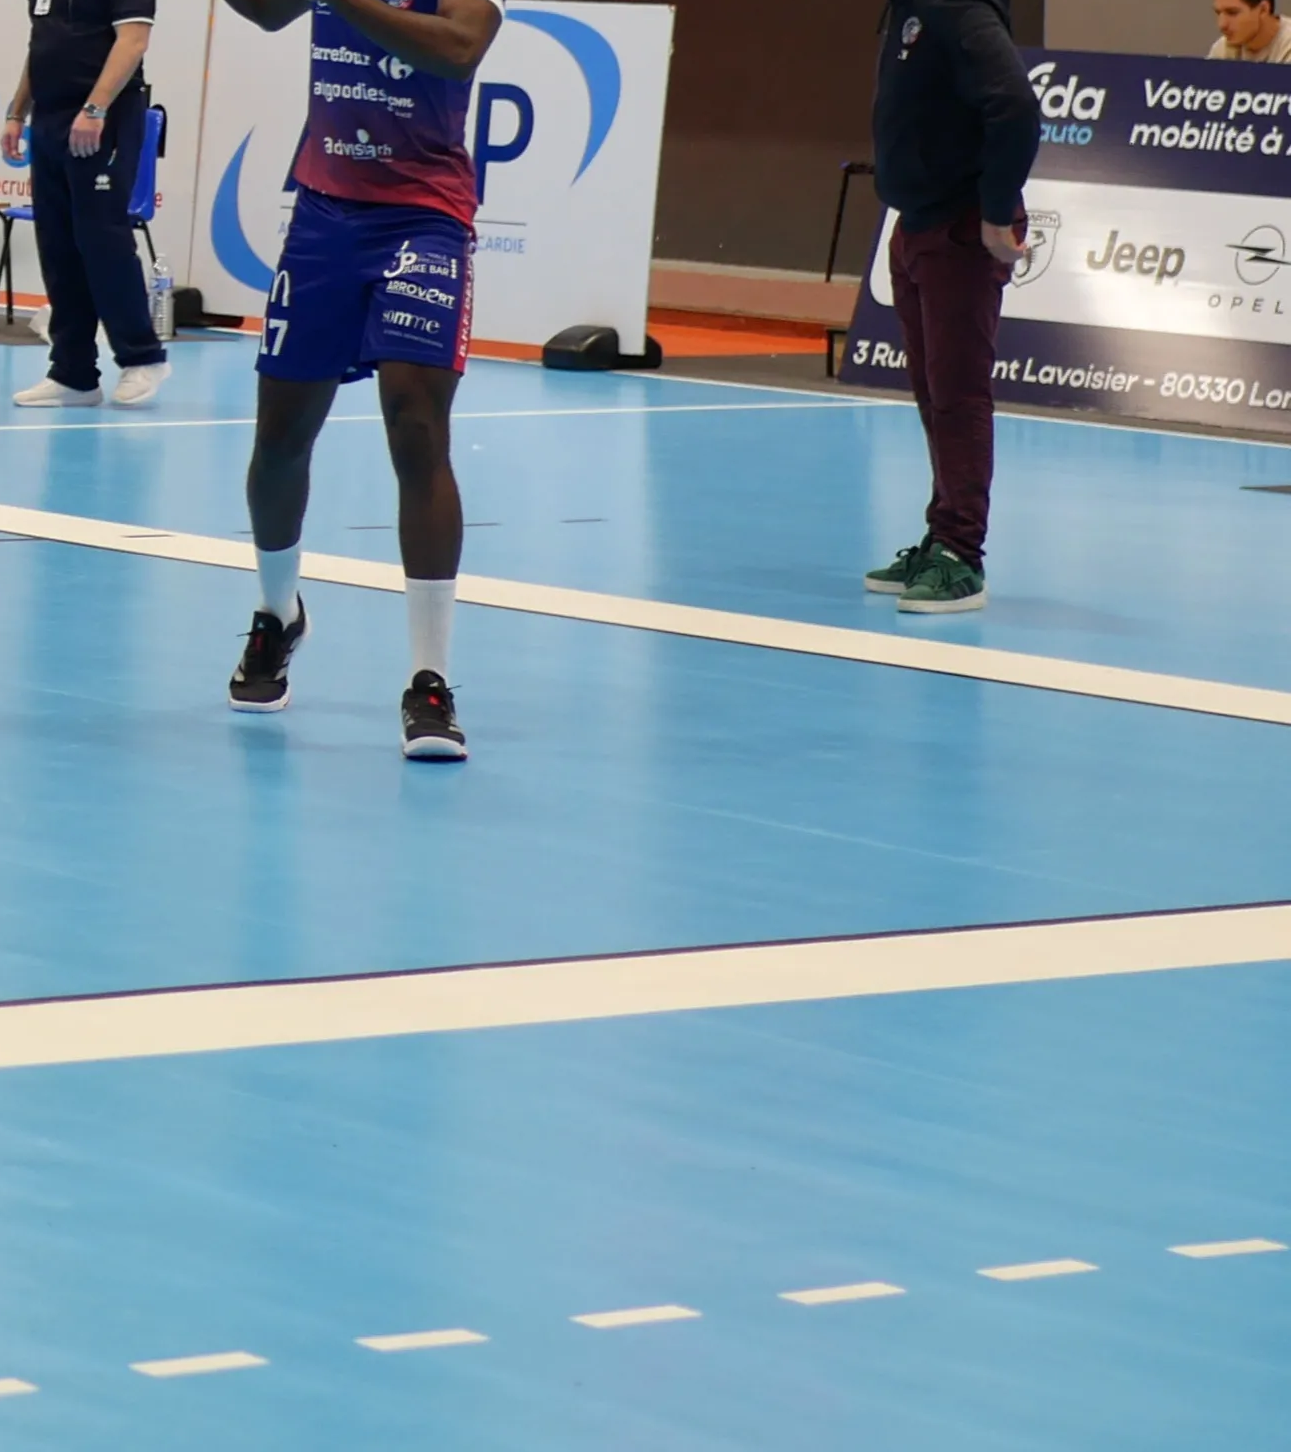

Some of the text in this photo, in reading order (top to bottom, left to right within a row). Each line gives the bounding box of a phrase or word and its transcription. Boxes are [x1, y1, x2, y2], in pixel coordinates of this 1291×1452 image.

[311, 43, 371, 66] arrefour
[1144, 78, 1226, 111] Votre
[1129, 119, 1255, 154] mobilité
[1260, 126, 1284, 156] à
[429, 264, 450, 277] BAR
[1086, 229, 1187, 286] Jeep
[1208, 294, 1285, 315] OPEL
[852, 339, 870, 365] 3
[1022, 356, 1139, 393] Lavoisier
[1160, 371, 1245, 404] 80330
